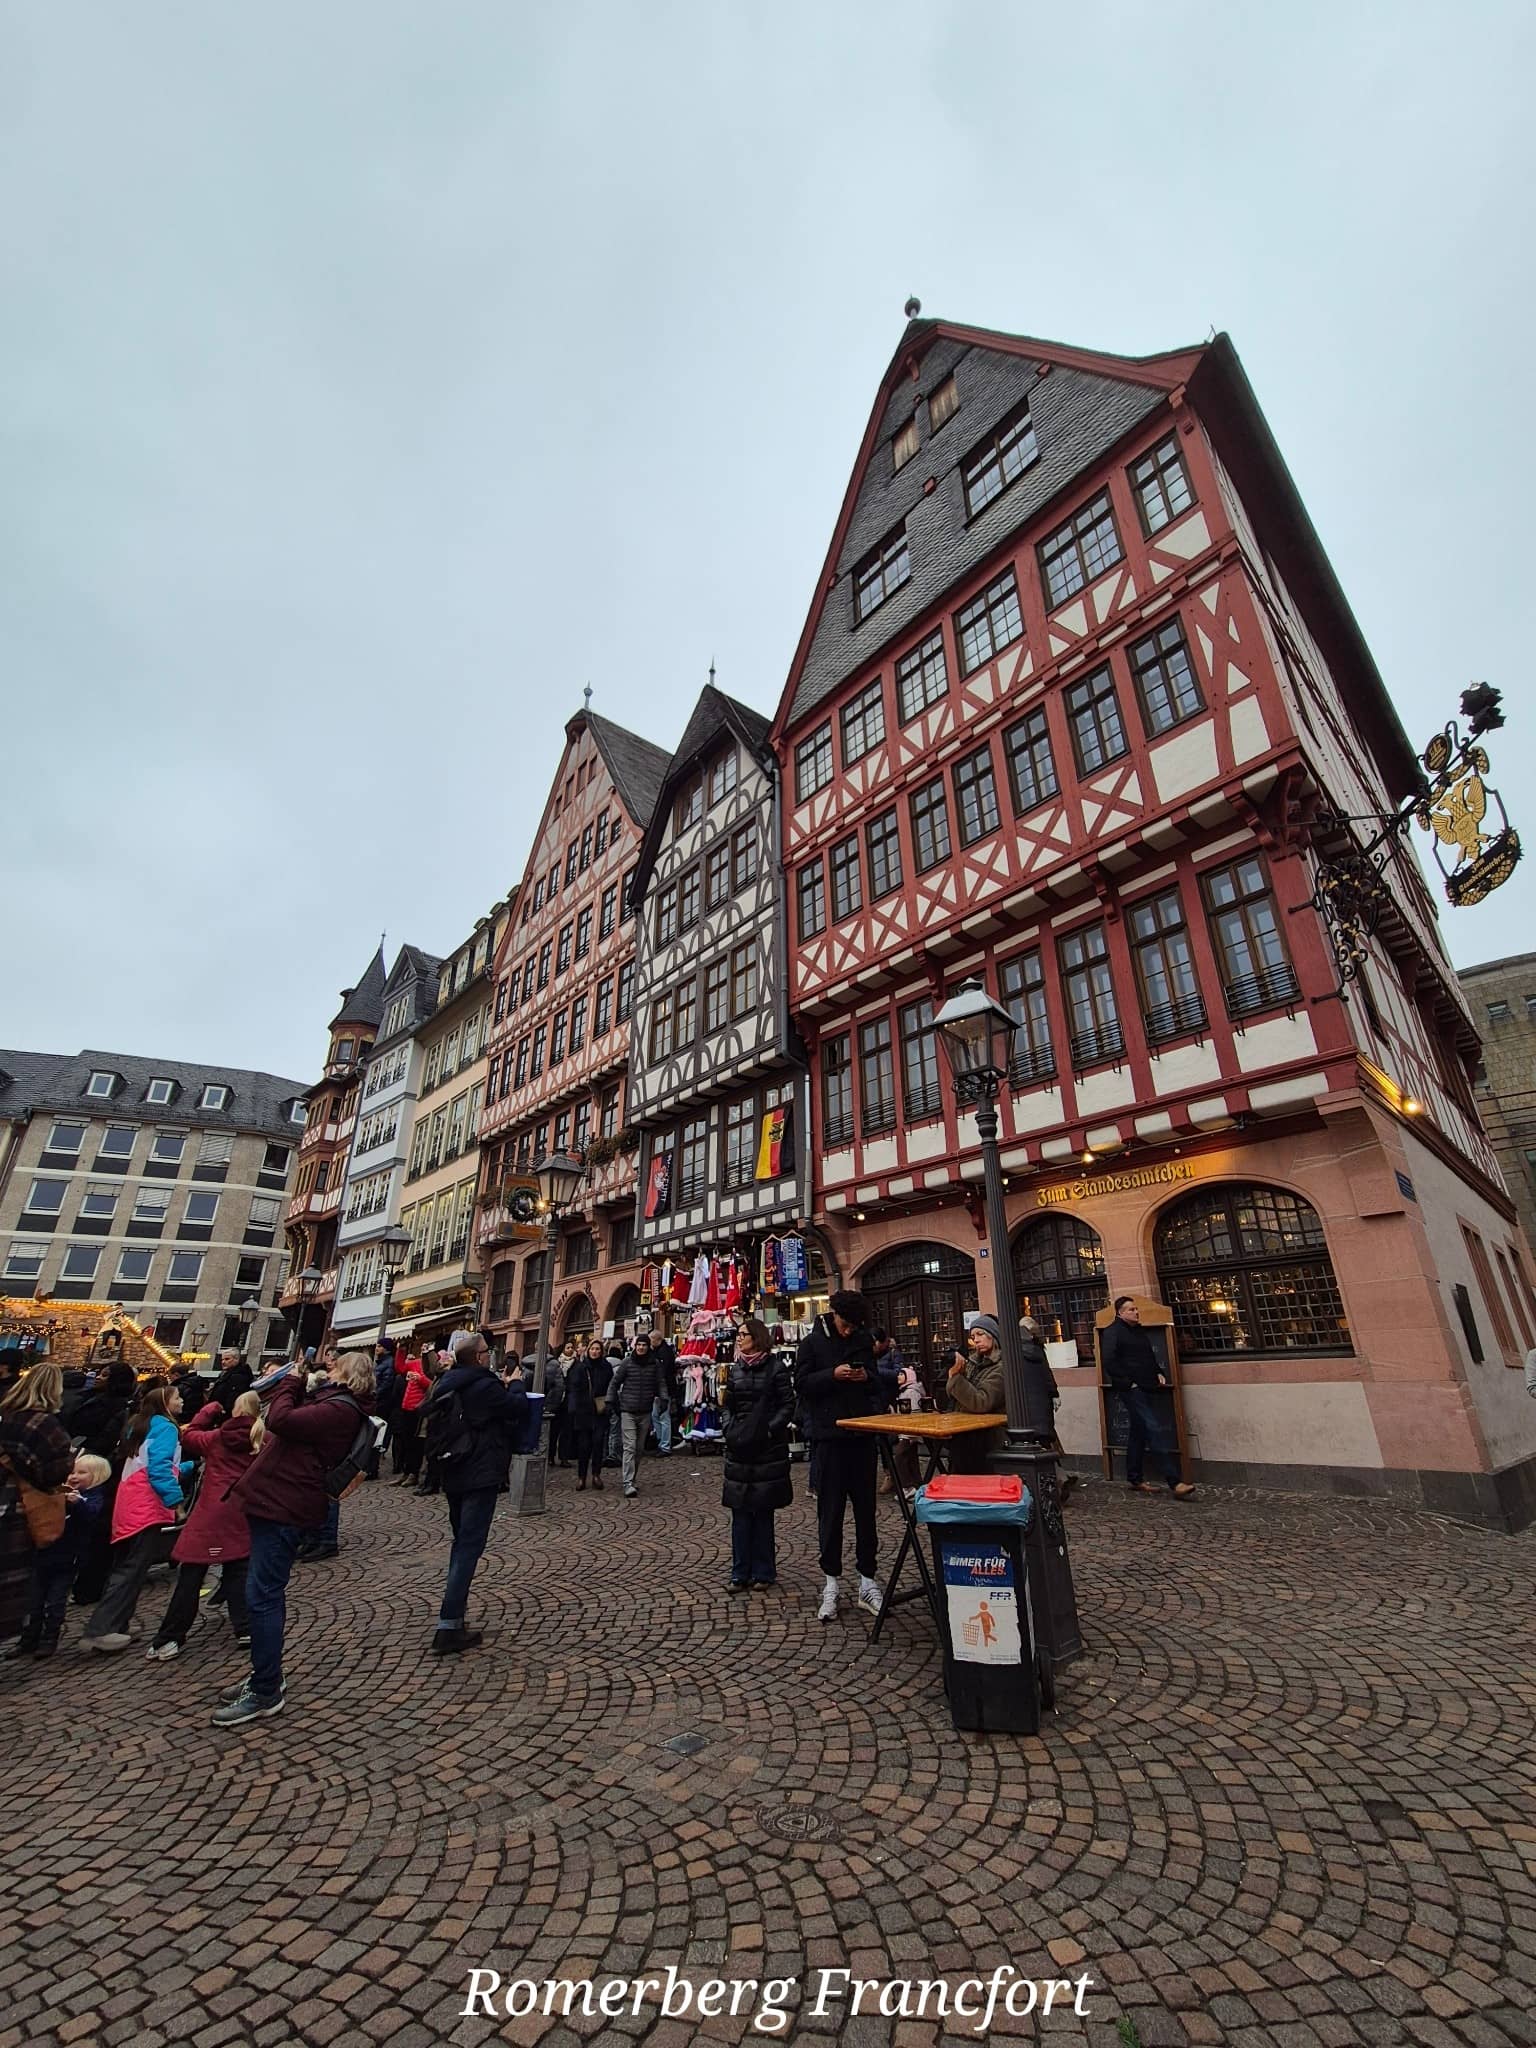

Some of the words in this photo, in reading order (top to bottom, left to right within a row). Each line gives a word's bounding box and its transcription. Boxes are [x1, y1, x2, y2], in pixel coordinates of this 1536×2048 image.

[1037, 1186, 1070, 1207] Zum
[1070, 1161, 1196, 1200] Standesämtchen
[949, 1556, 982, 1567] EIMER
[984, 1556, 1007, 1568] FÜR
[970, 1566, 1007, 1576] ALLES.
